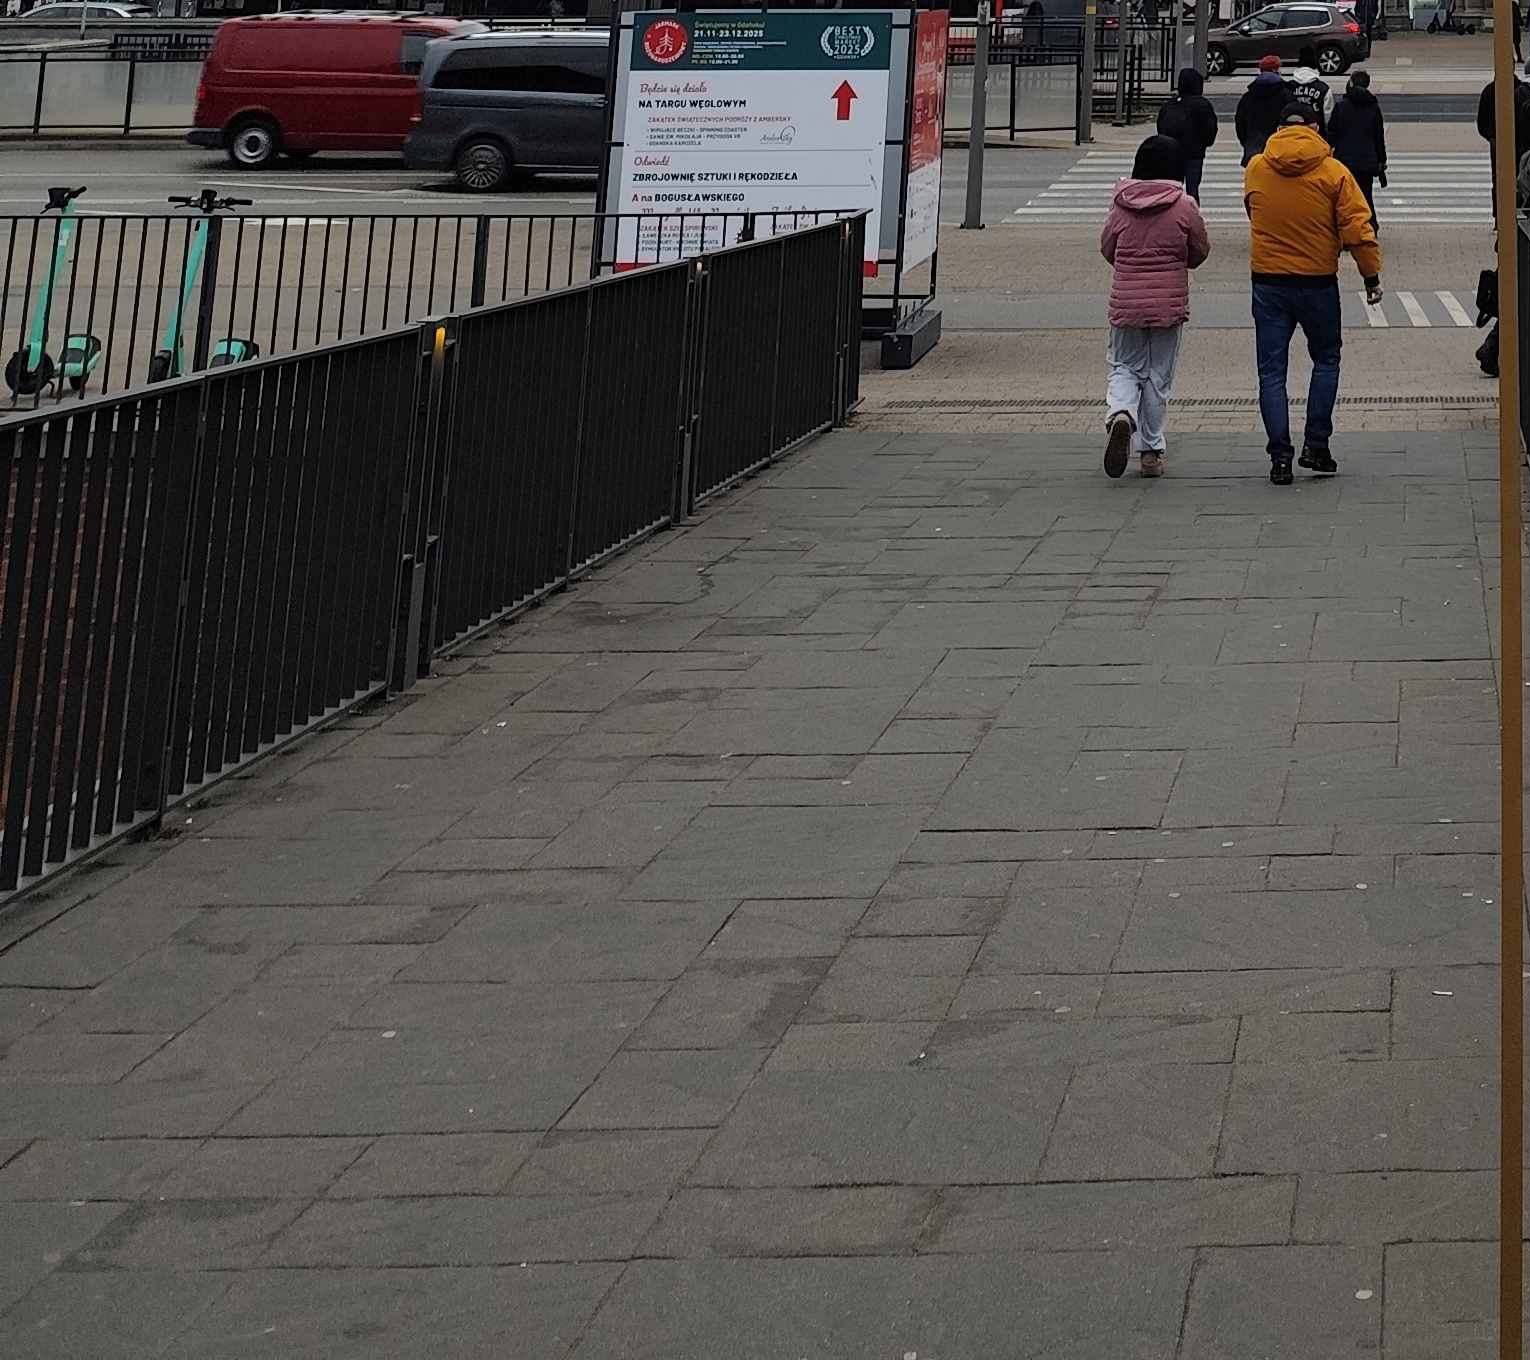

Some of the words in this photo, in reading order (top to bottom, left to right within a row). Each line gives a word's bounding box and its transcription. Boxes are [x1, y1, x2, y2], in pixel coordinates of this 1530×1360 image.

[835, 26, 861, 35] BEST
[834, 45, 860, 54] 2025
[639, 99, 652, 108] NA
[655, 99, 687, 108] TARGU
[689, 99, 747, 110] WĘGLOWYM
[633, 173, 695, 183] ZBROJOWNIĘ
[697, 172, 732, 181] SZTUKI
[738, 171, 798, 182] RĘKODZIEŁA
[632, 194, 640, 202] A
[654, 192, 745, 202] BOGUSŁAWSKIEGO
